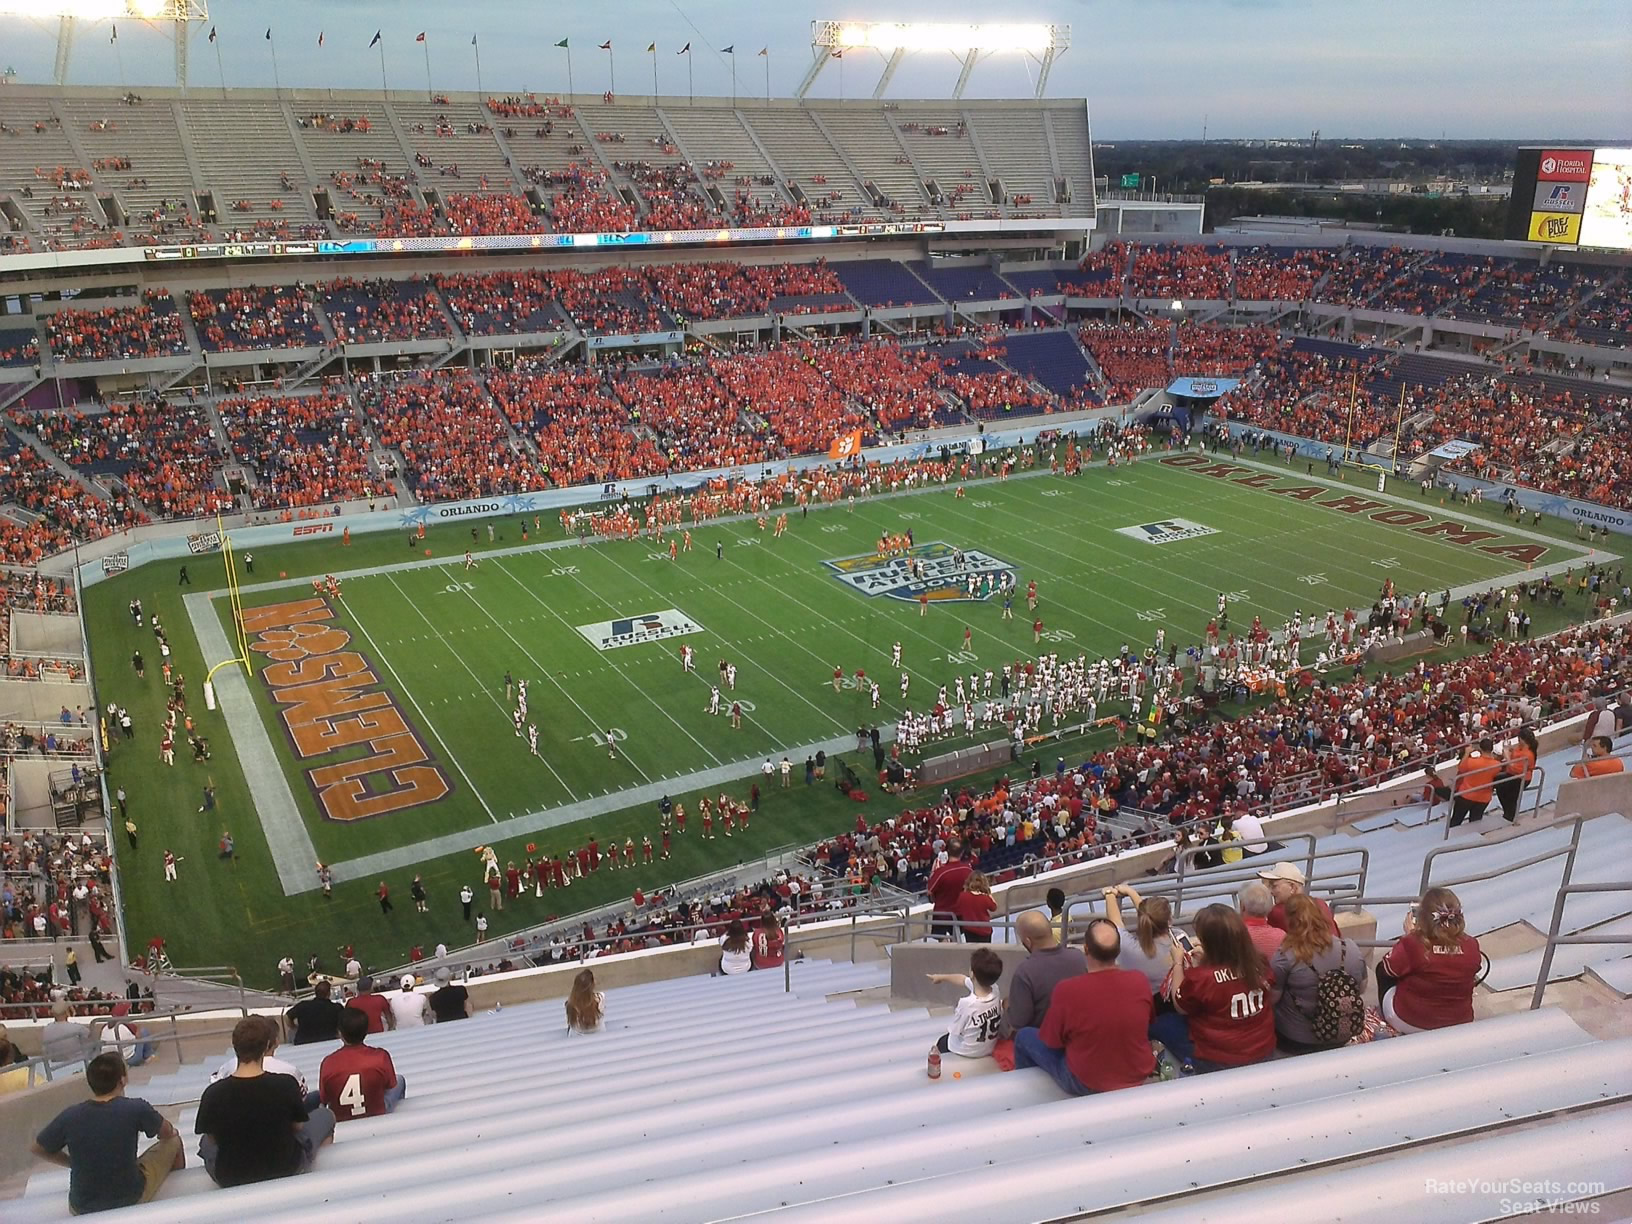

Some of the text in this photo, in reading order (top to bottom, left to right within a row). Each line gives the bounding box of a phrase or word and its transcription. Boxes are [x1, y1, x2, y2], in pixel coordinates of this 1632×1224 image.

[1557, 166, 1587, 174] HOSPITAL
[1547, 217, 1569, 227] TIRES
[1548, 225, 1569, 236] PLUS
[440, 503, 500, 518] ORLANDO
[1158, 455, 1551, 564] OKLAHOMA
[1572, 507, 1624, 526] ORLANDO
[293, 522, 334, 537] ESPN
[908, 574, 986, 591] BOW
[947, 651, 979, 665] 40
[236, 596, 450, 821] CLEMSN
[587, 727, 629, 748] 10
[339, 1073, 367, 1116] 4
